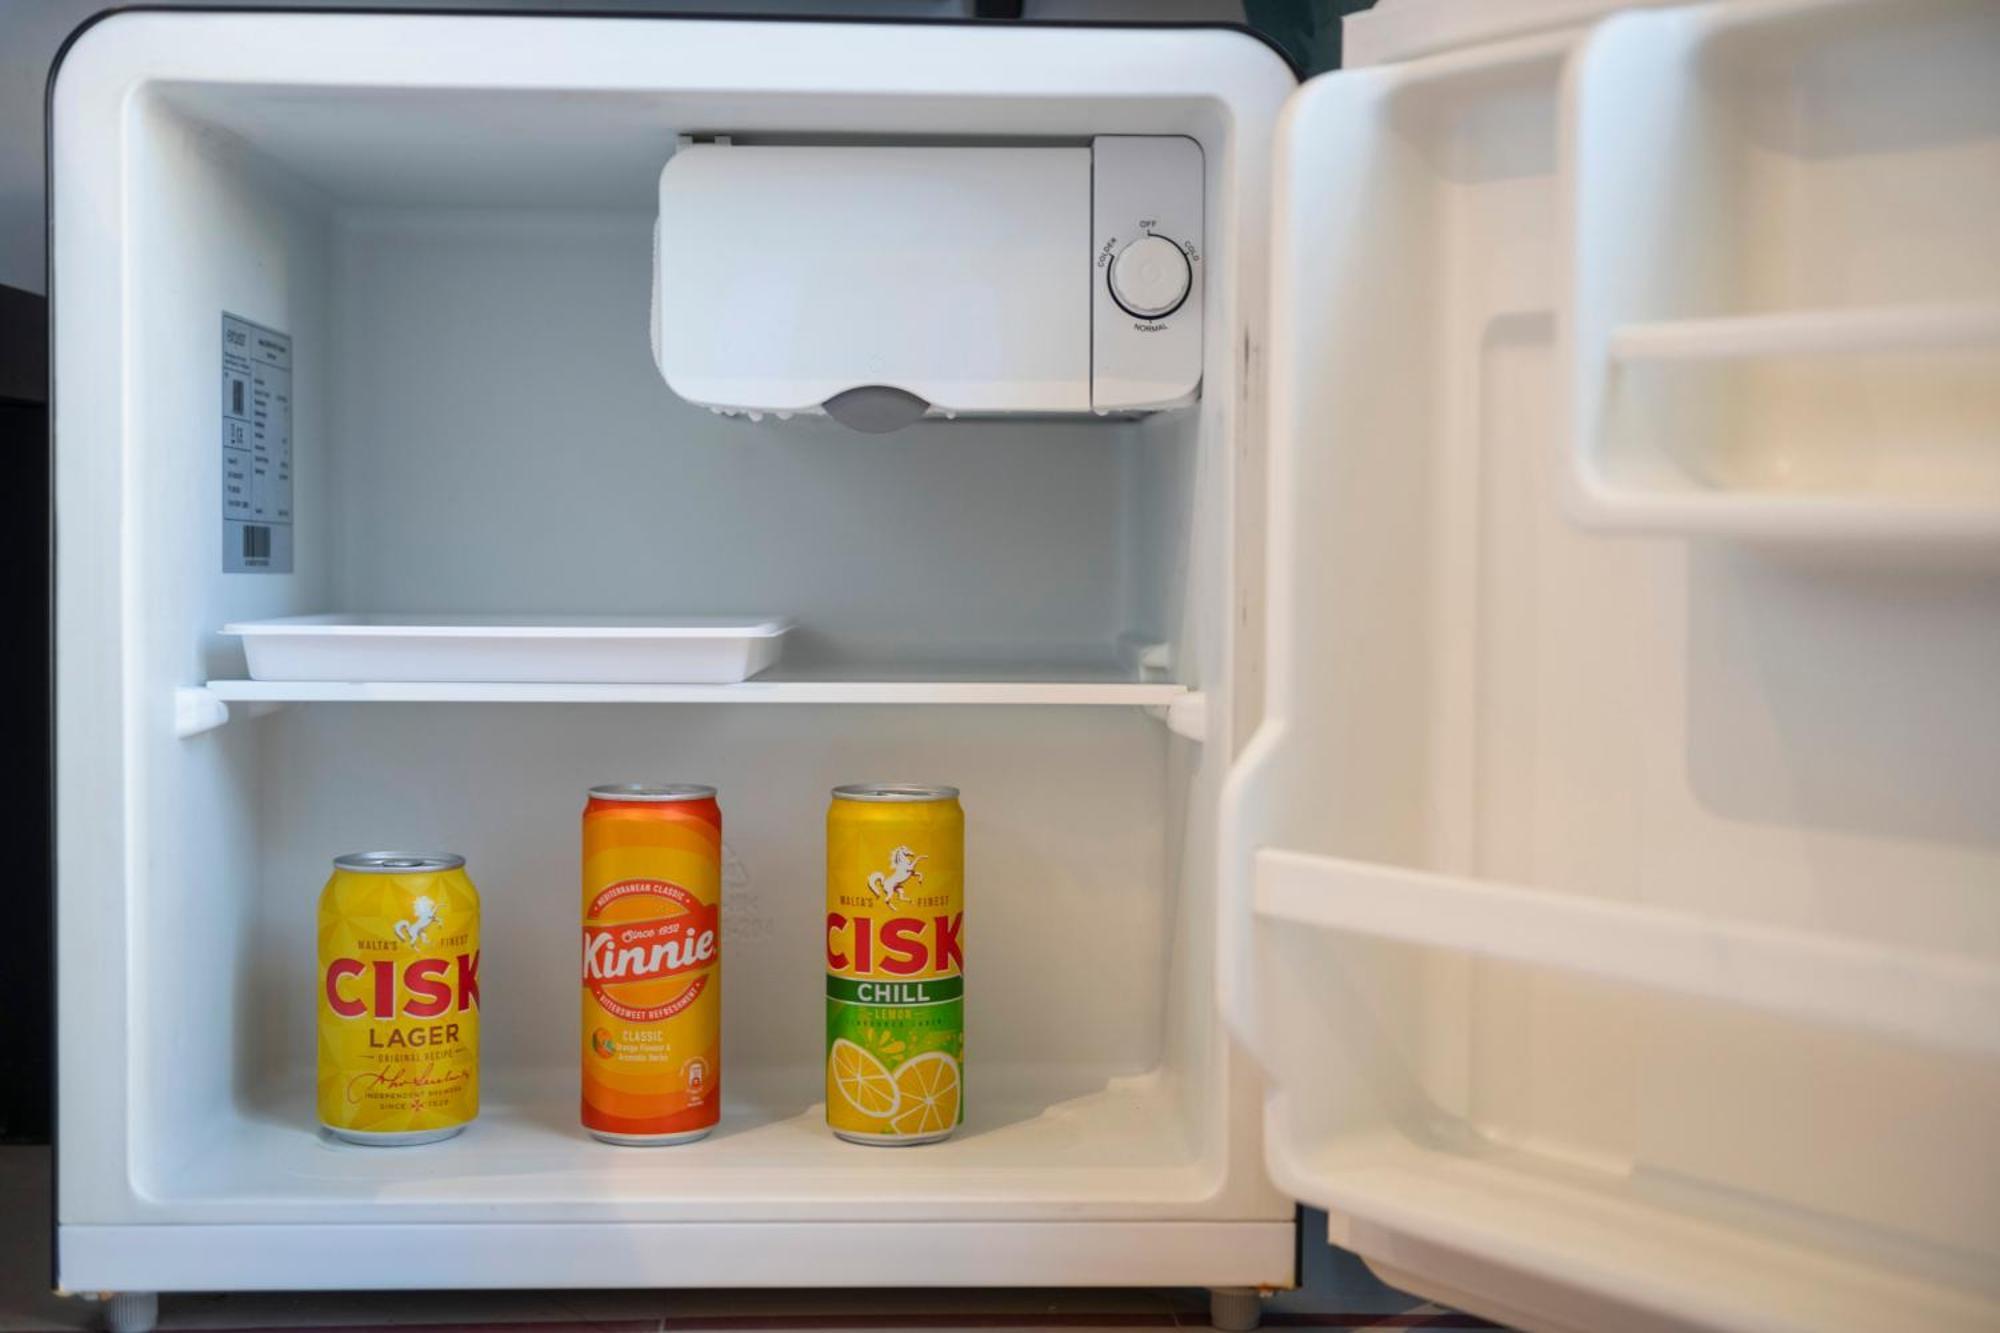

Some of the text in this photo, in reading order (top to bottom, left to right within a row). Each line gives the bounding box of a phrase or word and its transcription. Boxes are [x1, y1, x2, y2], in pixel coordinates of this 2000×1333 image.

[1139, 220, 1156, 228] OFF
[1185, 241, 1200, 261] COLD
[1134, 323, 1167, 332] NORMAL
[653, 884, 685, 901] CLASSIC
[917, 895, 949, 907] FINEST
[826, 910, 963, 975] CISK
[583, 927, 714, 979] Kinnie
[326, 948, 480, 1018] CISK
[857, 983, 930, 1003] CHILL
[369, 1023, 459, 1049] LAGER
[623, 1030, 663, 1041] CLASSIC
[379, 1103, 407, 1111] SINCE
